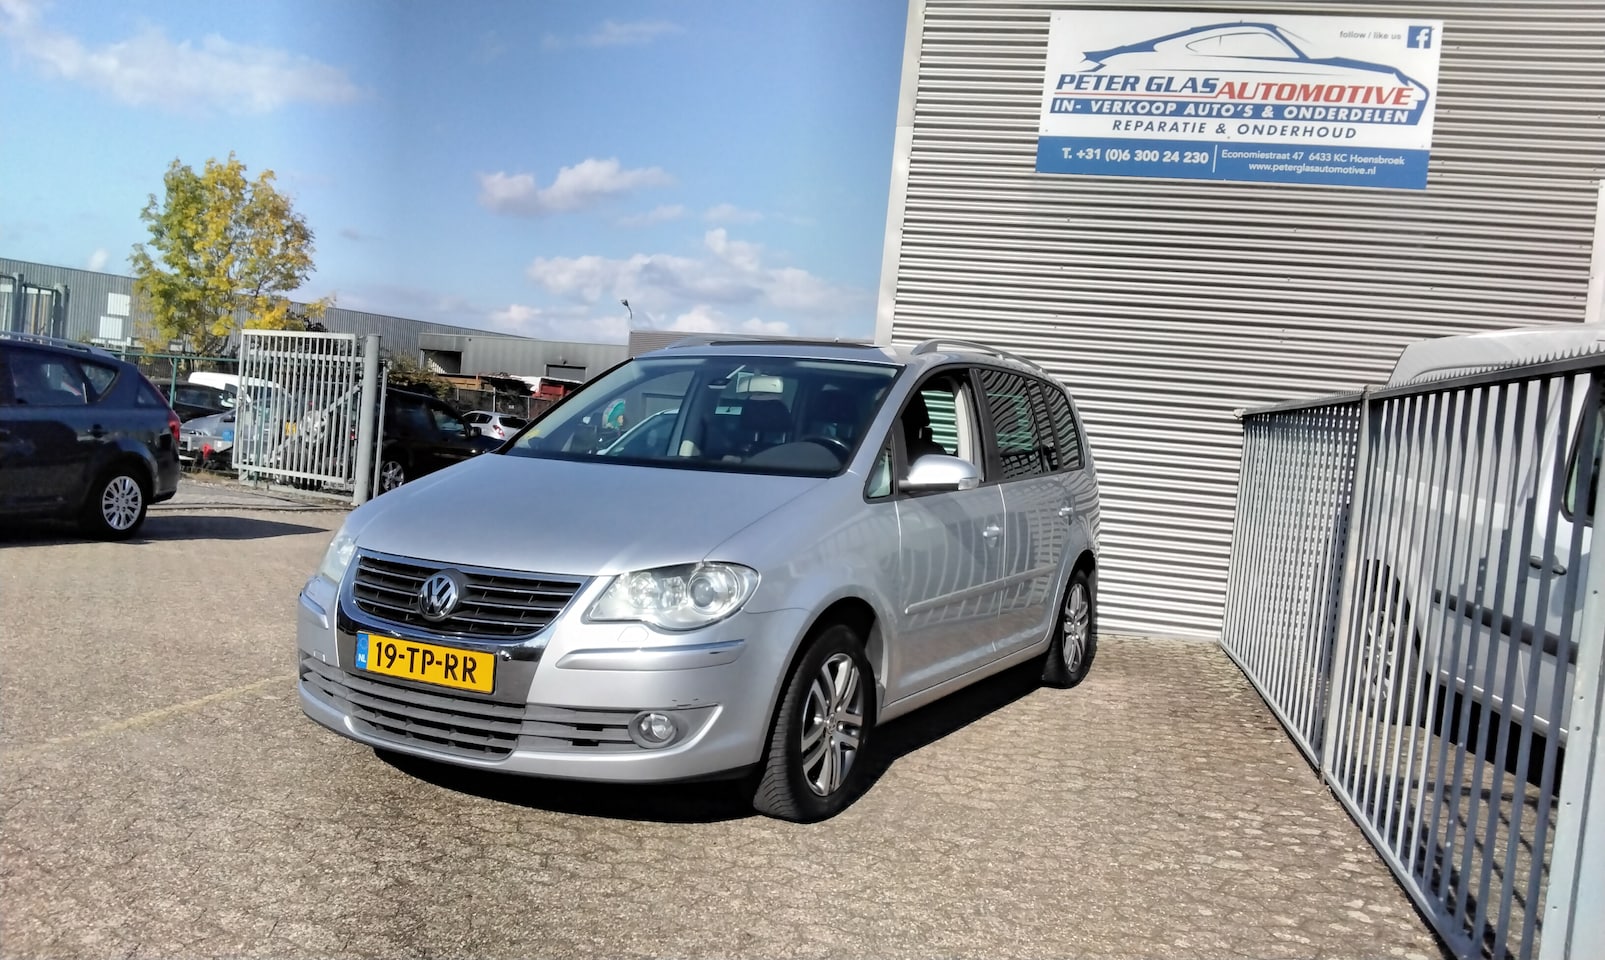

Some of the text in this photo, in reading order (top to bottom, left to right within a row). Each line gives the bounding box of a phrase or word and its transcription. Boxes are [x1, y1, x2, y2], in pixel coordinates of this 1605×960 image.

[1340, 30, 1366, 39] follow
[1373, 31, 1389, 40] like
[1391, 32, 1402, 40] us
[1055, 74, 1140, 92] PETER
[1054, 99, 1409, 123] IN- VERKOOP AUTO'S & ONDERDELEN
[1112, 119, 1357, 139] REPARATIE & ONDERHOUD
[1061, 147, 1209, 164] T. +31 (0)6 300 24 230
[1221, 149, 1405, 165] Economiestraat 47 6433 KC Hoensbroek
[1249, 162, 1376, 175] www.peterglasautomotive.nl
[358, 641, 477, 684] NL 19-TP-RR
